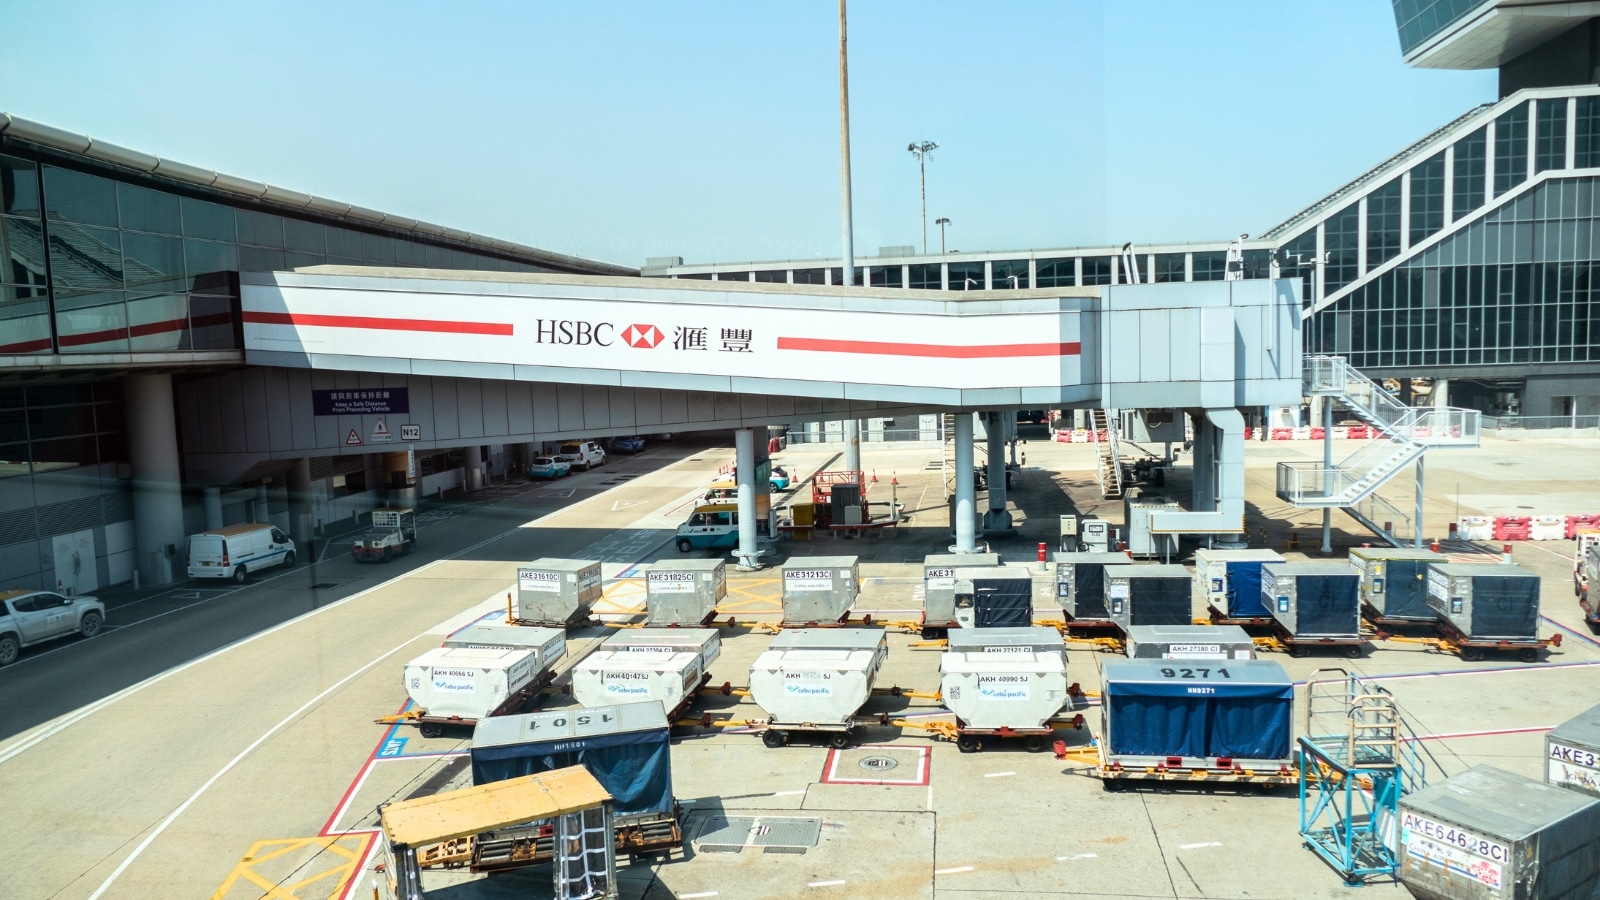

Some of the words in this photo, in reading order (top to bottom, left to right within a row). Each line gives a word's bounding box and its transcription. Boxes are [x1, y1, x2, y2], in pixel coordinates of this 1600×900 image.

[535, 319, 614, 347] HSBC
[1160, 668, 1231, 679] 9271
[529, 714, 614, 730] 1501
[1551, 745, 1600, 766] AKE3
[1404, 814, 1508, 863] AKE64628CI
